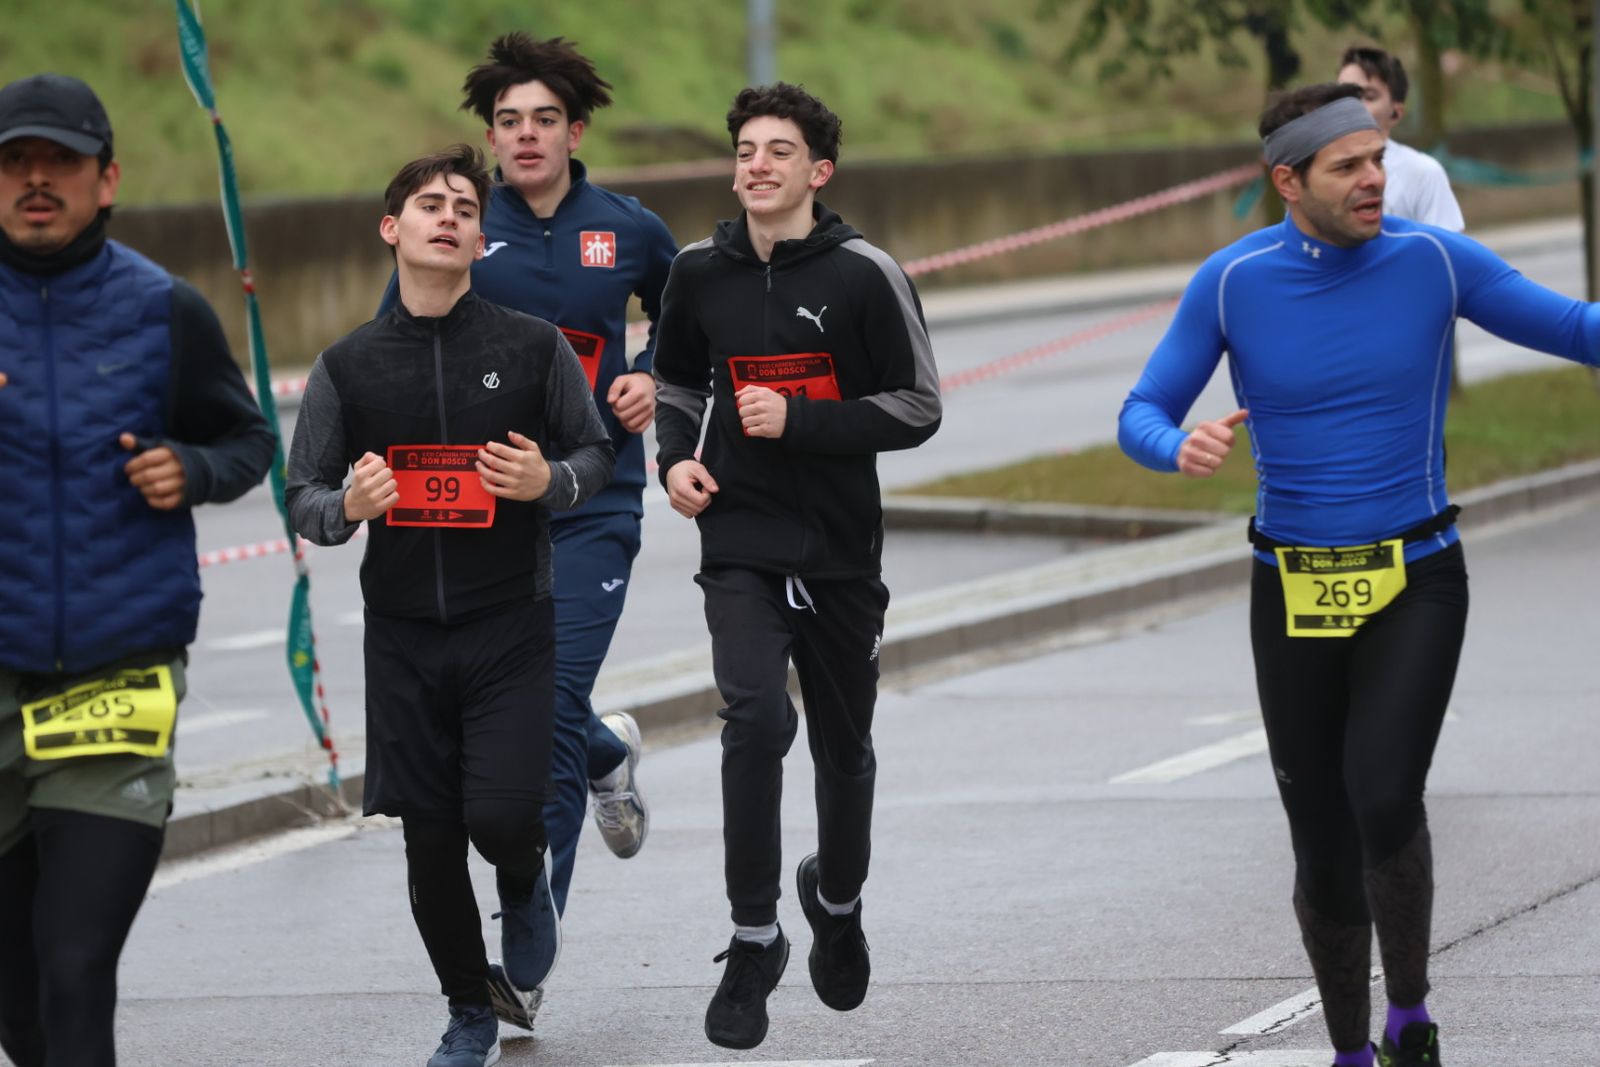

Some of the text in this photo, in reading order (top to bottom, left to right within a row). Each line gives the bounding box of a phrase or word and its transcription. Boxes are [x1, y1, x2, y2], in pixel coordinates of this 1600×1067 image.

[777, 366, 806, 375] BOSCO
[421, 457, 467, 465] DON BOSCO
[425, 476, 460, 502] 99
[1312, 559, 1333, 568] DON
[1313, 578, 1372, 607] 269
